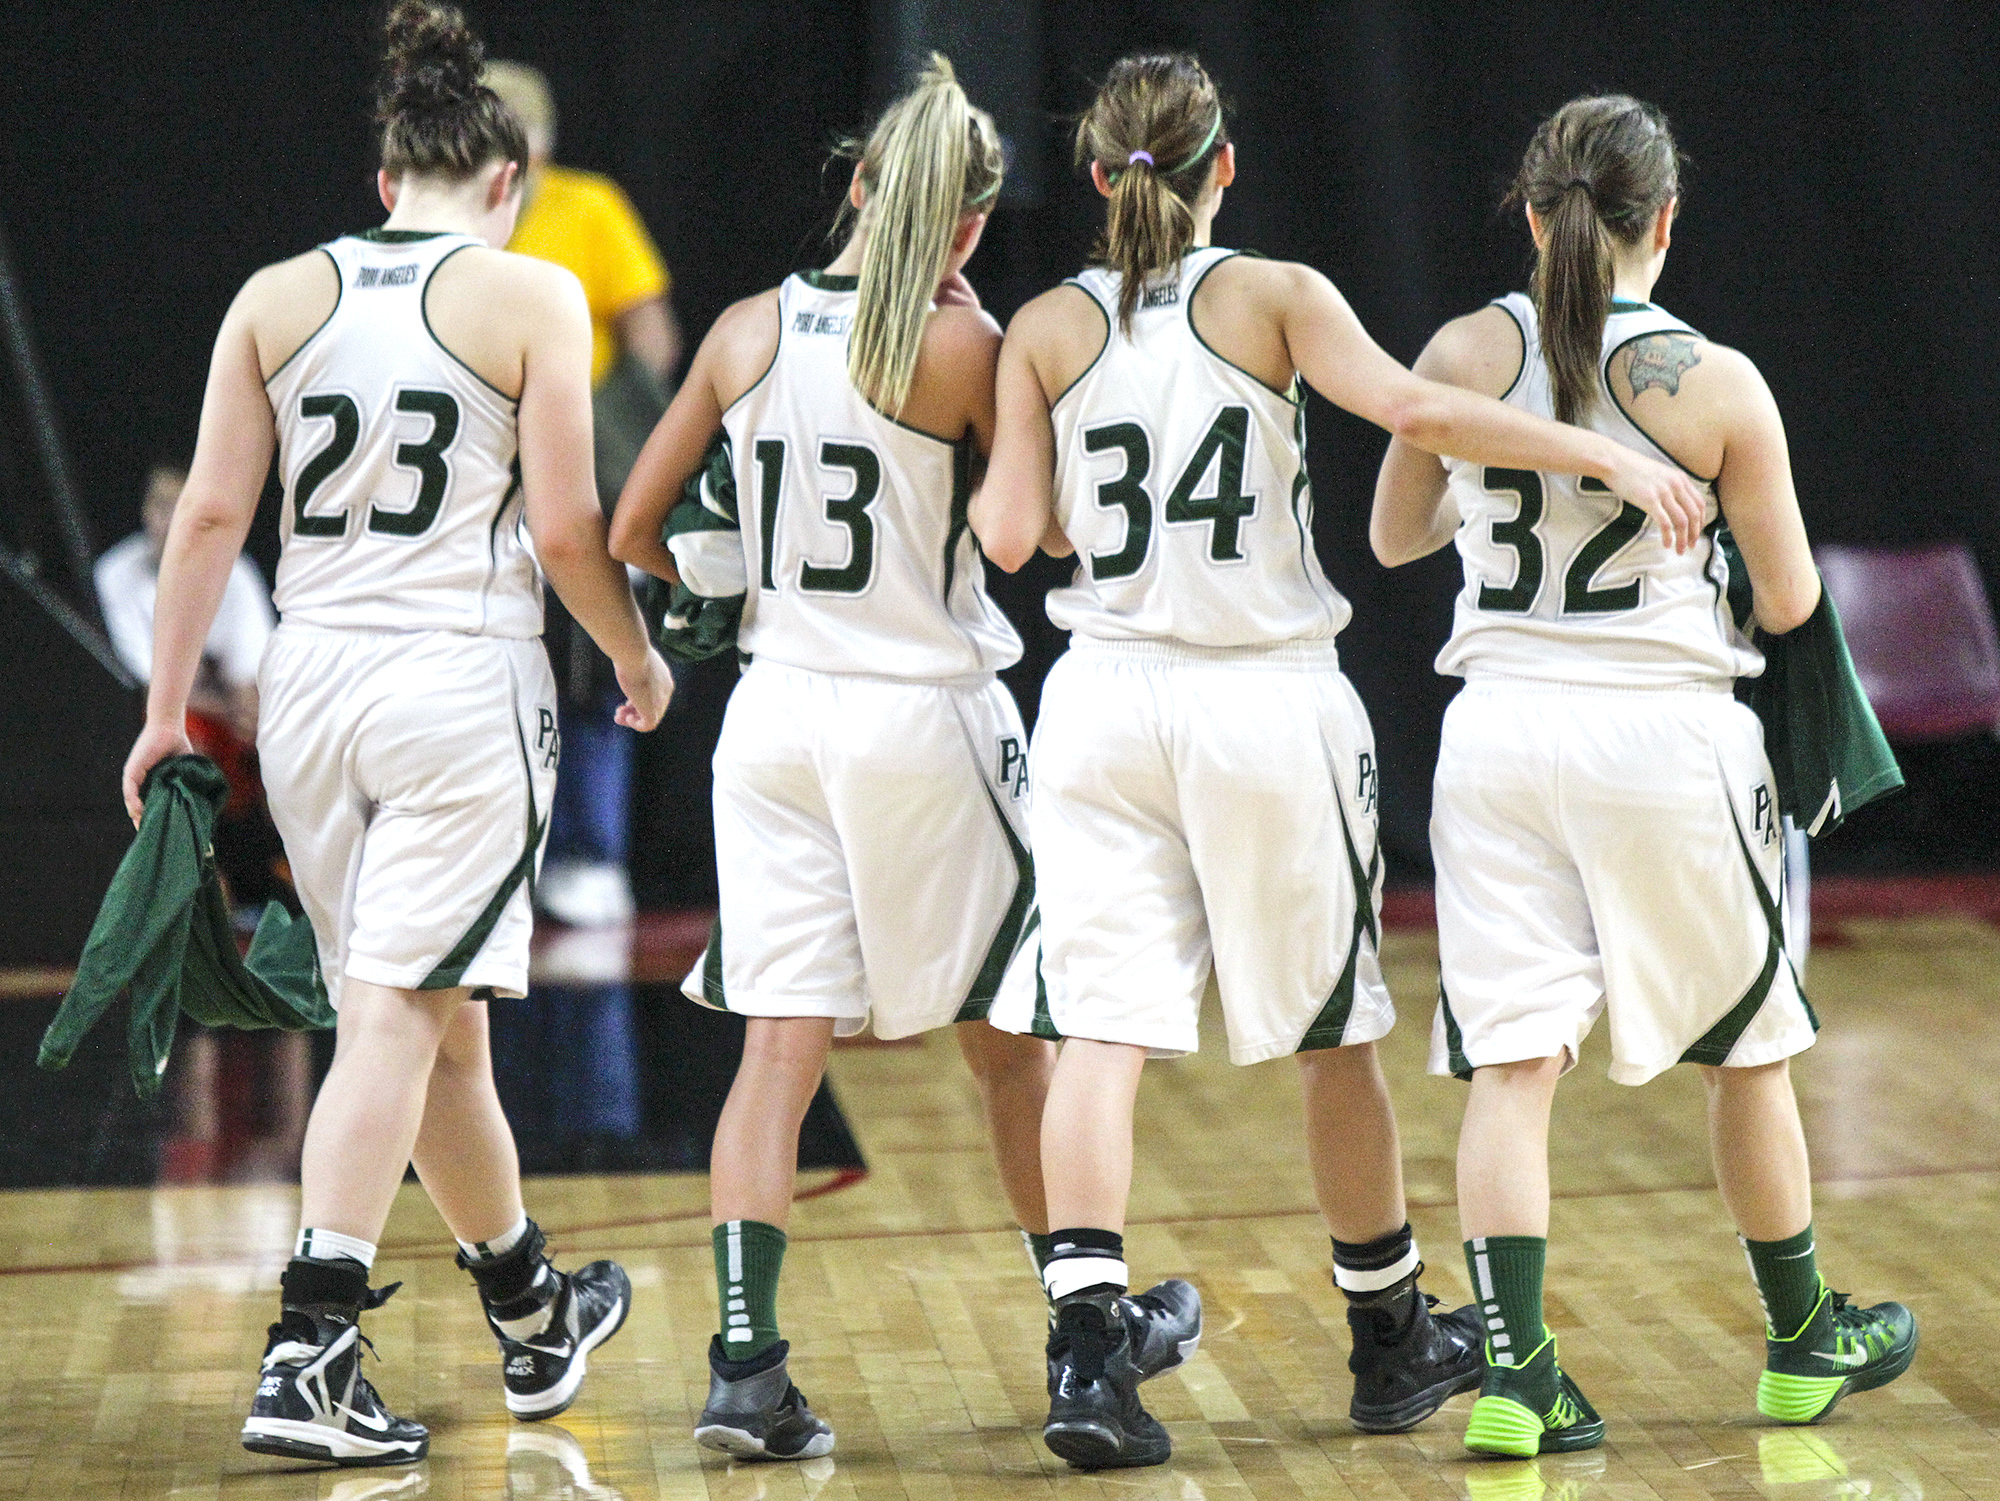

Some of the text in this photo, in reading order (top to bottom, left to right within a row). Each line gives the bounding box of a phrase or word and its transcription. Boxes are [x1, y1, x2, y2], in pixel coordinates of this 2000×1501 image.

[292, 386, 461, 539] 23
[1082, 403, 1258, 583] 34
[753, 437, 882, 595] 13
[1476, 466, 1649, 615] 32
[537, 708, 558, 769] PA
[1000, 737, 1029, 798] PA
[1358, 752, 1377, 813] PA
[1753, 784, 1777, 845] PA
